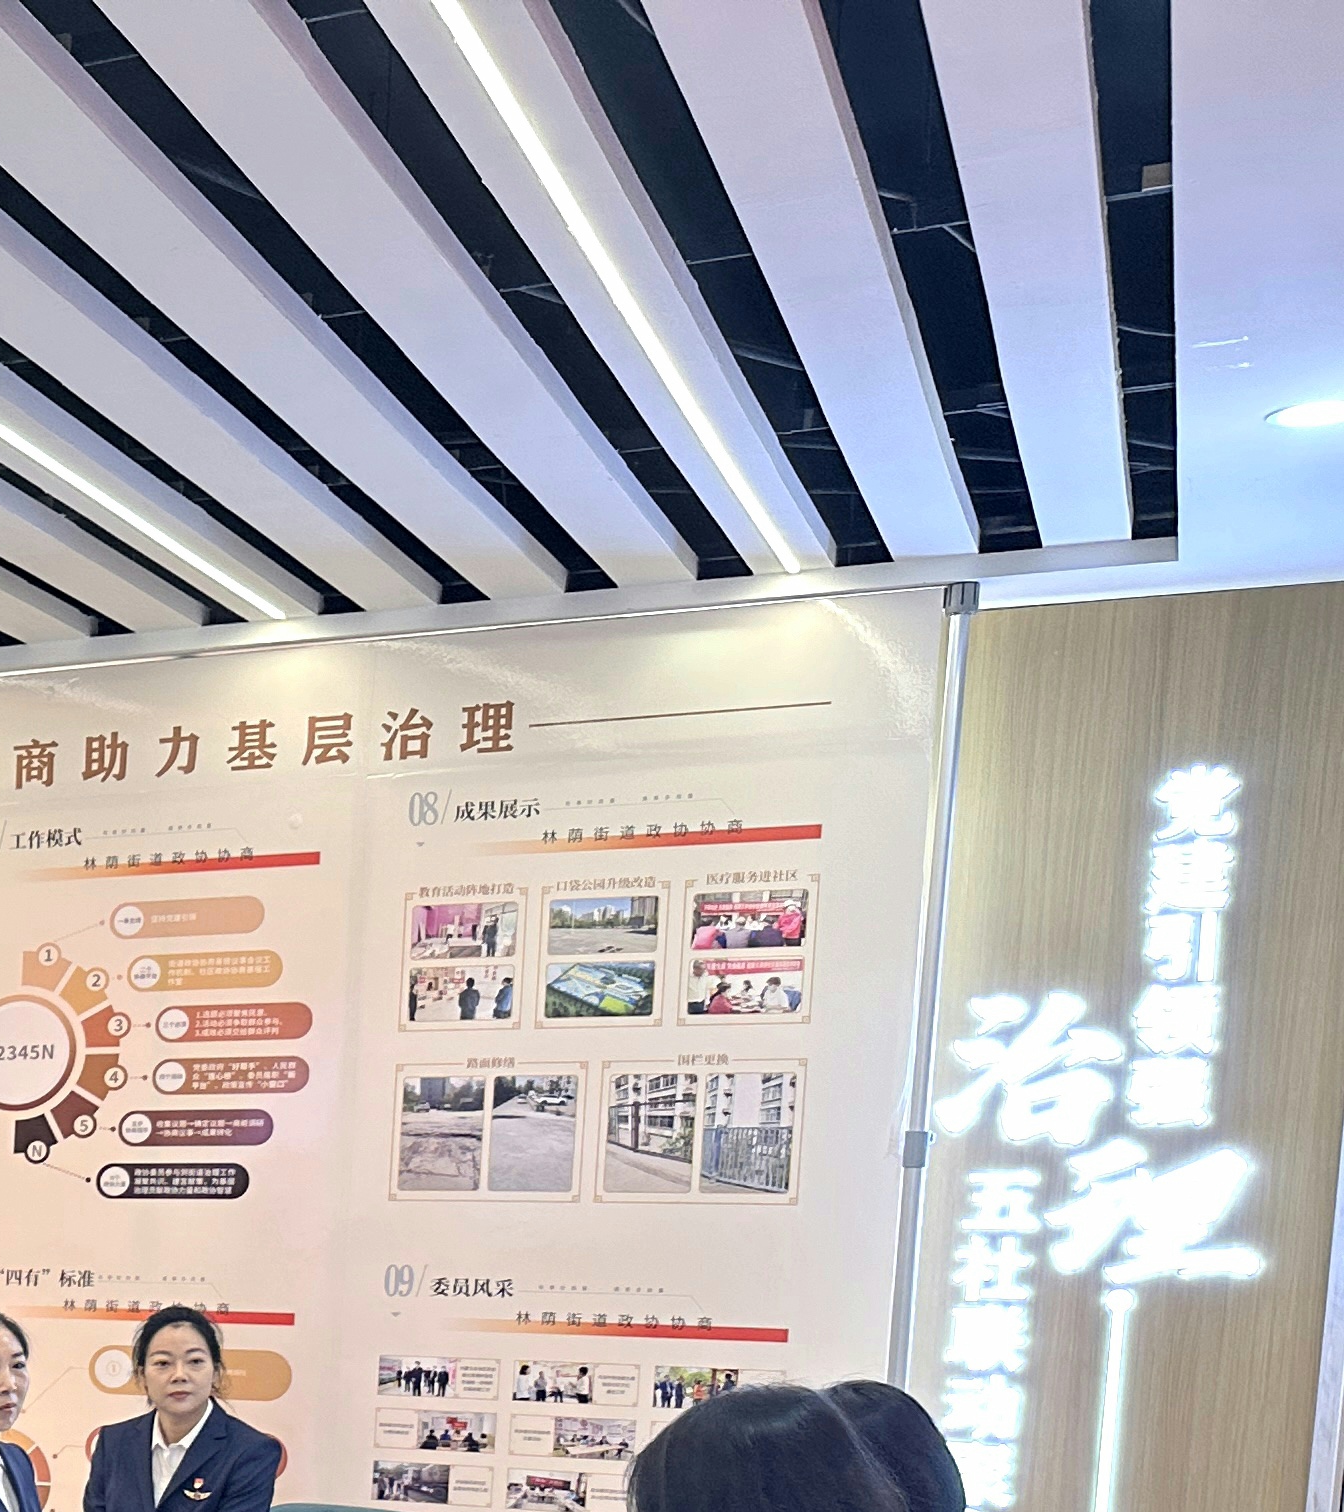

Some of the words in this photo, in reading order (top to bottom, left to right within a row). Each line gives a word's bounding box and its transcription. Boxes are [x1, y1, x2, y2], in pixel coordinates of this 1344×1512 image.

[453, 798, 541, 822] 成果展示
[11, 826, 83, 851] 工作模式
[541, 818, 745, 845] 林荫街道政协协商
[83, 845, 256, 871] 林荫街道政协协商
[556, 875, 656, 893] 口袋公园升级改造
[705, 869, 800, 886] 医疗服务进社区
[418, 882, 515, 899] 教育活动阵地打造
[43, 949, 53, 962] 1
[90, 973, 102, 988] 2
[113, 1018, 124, 1033] 3
[109, 1070, 120, 1084] 4
[79, 1119, 89, 1133] 5
[31, 1143, 43, 1158] N
[430, 1276, 514, 1298] 委员风采
[515, 1310, 714, 1332] 林荫街道政协协商
